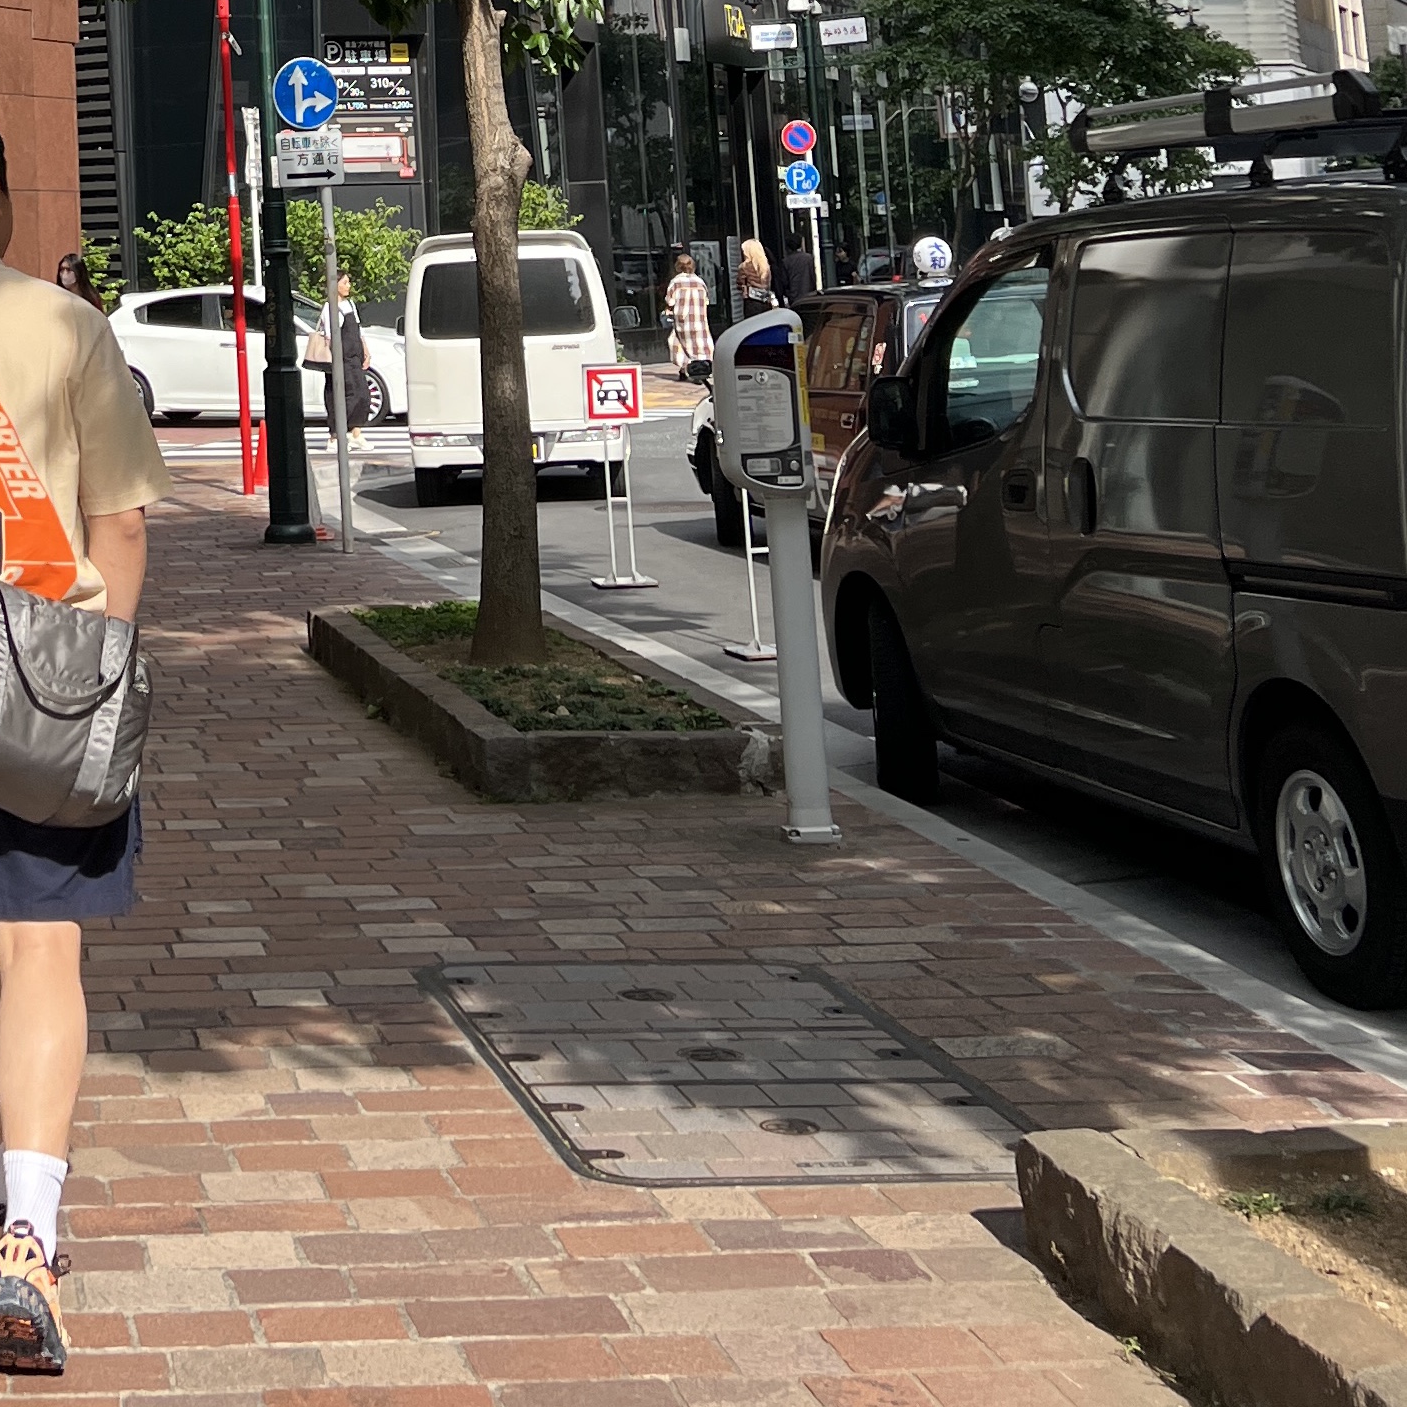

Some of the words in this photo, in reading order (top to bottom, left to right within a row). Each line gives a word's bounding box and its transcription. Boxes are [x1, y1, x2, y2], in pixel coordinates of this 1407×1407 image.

[344, 49, 388, 64] 駐車場
[280, 135, 339, 151] 自転車を除く
[281, 152, 339, 167] 一方通行
